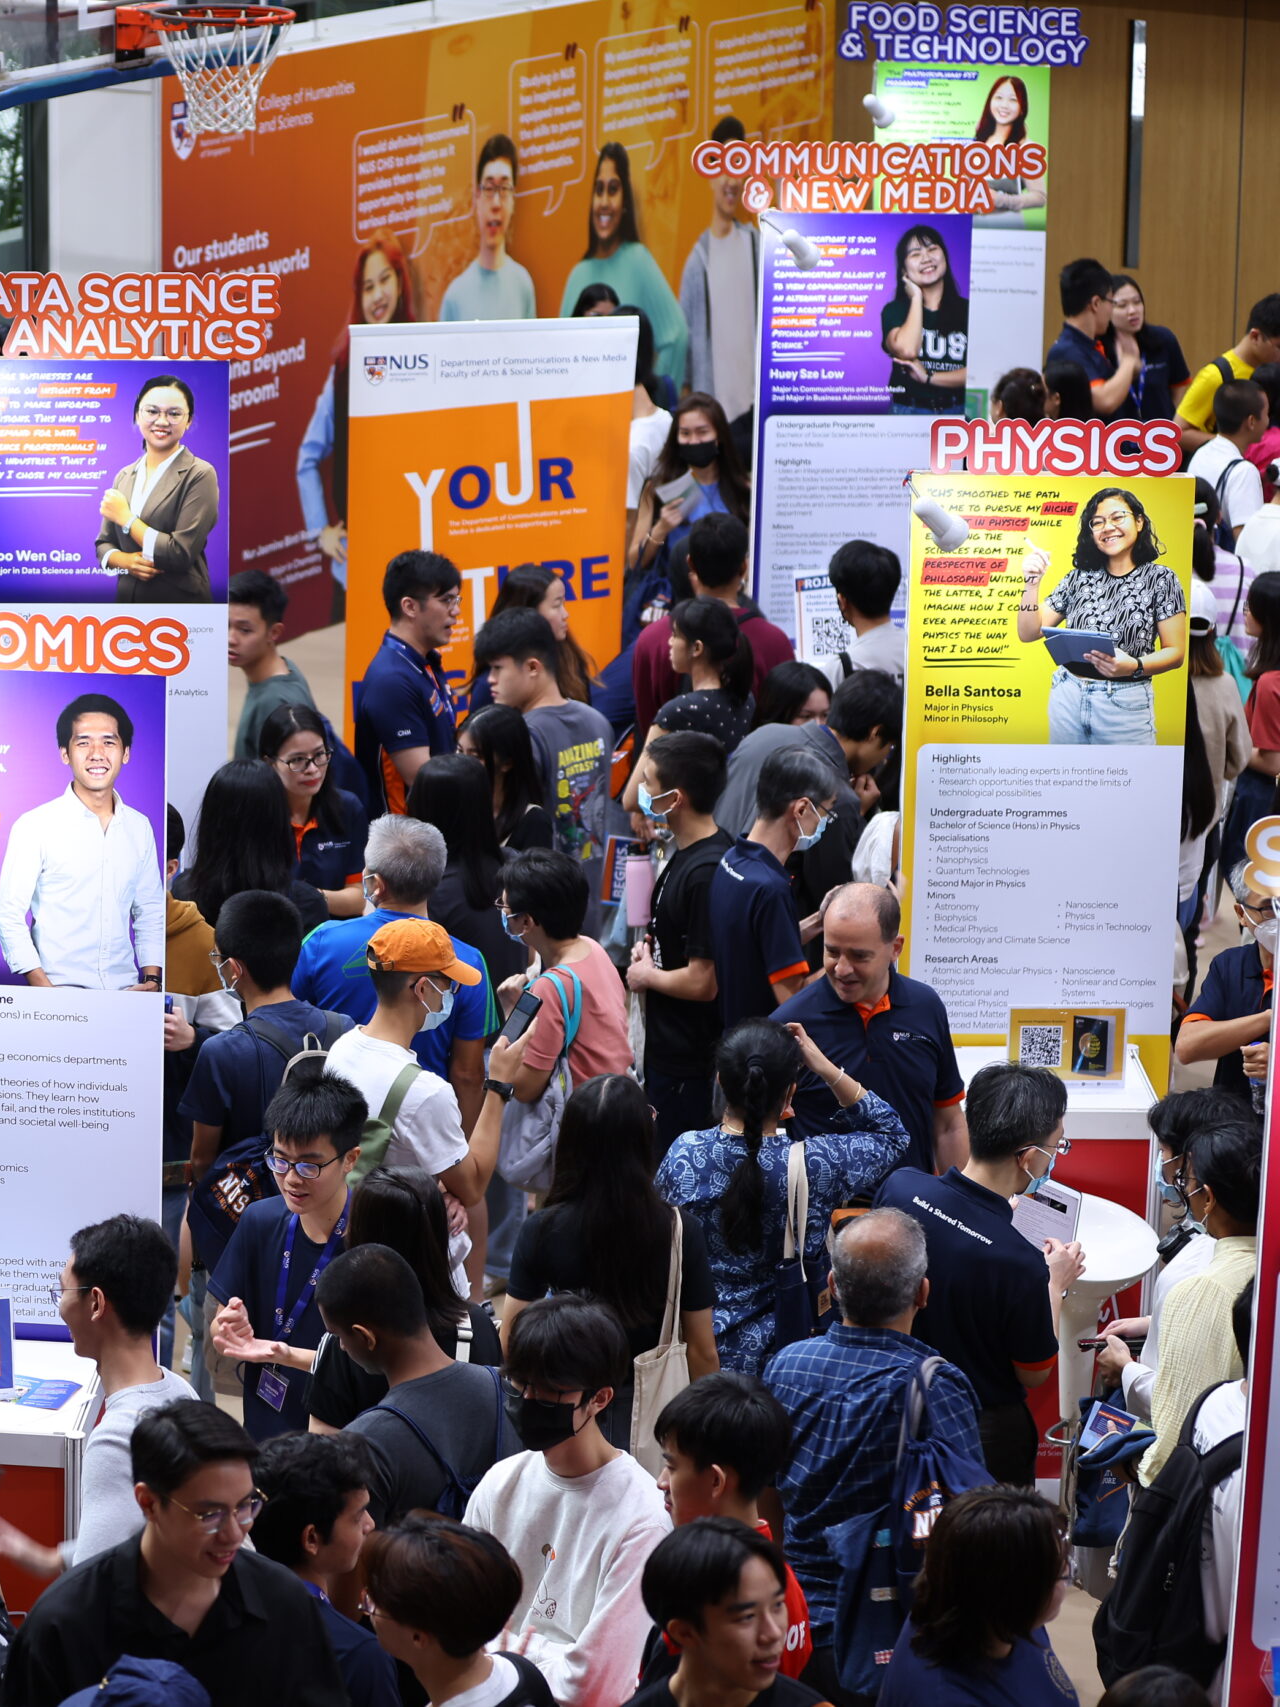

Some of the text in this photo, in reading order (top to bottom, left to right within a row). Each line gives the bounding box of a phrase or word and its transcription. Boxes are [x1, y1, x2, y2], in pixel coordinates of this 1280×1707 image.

[850, 6, 1079, 36] FOOD SCIENCE
[841, 33, 1087, 65] & TECHNOLOGY
[259, 81, 355, 112] College of Humanities
[259, 113, 313, 134] and Sciences
[698, 146, 1045, 176] COMMUNICATIONS
[748, 180, 989, 209] & NEW MEDIA
[174, 230, 268, 269] Our students
[268, 247, 310, 277] world
[85, 278, 275, 314] SCIENCE
[8, 319, 261, 355] ANALYTICS
[254, 338, 305, 373] beyond
[390, 354, 429, 370] NUS
[440, 358, 489, 368] Department
[492, 357, 500, 366] of
[503, 355, 570, 366] Communications
[582, 354, 600, 362] New
[602, 354, 627, 362] Media
[440, 369, 468, 379] Faculty
[472, 368, 480, 376] of
[482, 367, 499, 376] Arts
[510, 366, 532, 376] Social
[536, 366, 568, 374] Sciences
[770, 369, 844, 381] Huey Sze Low
[937, 426, 1176, 471] PHYSICS
[16, 551, 47, 562] Wen
[50, 550, 81, 563] Qiao
[75, 566, 90, 574] and
[92, 567, 128, 576] Analytics
[925, 686, 1021, 697] Bella Santosa
[925, 704, 948, 712] Major
[962, 704, 993, 712] Physics
[962, 715, 1008, 724] Philosophy
[932, 754, 981, 765] Highlights
[930, 808, 1067, 818] Undergraduate Programmes
[23, 1012, 31, 1020] in
[33, 1011, 88, 1023] Economics
[7, 1052, 61, 1063] economics
[63, 1054, 127, 1066] departments
[219, 1172, 249, 1212] NUS
[913, 1196, 930, 1210] Build
[933, 1209, 957, 1226] Shared
[957, 1221, 992, 1244] Tomorrow
